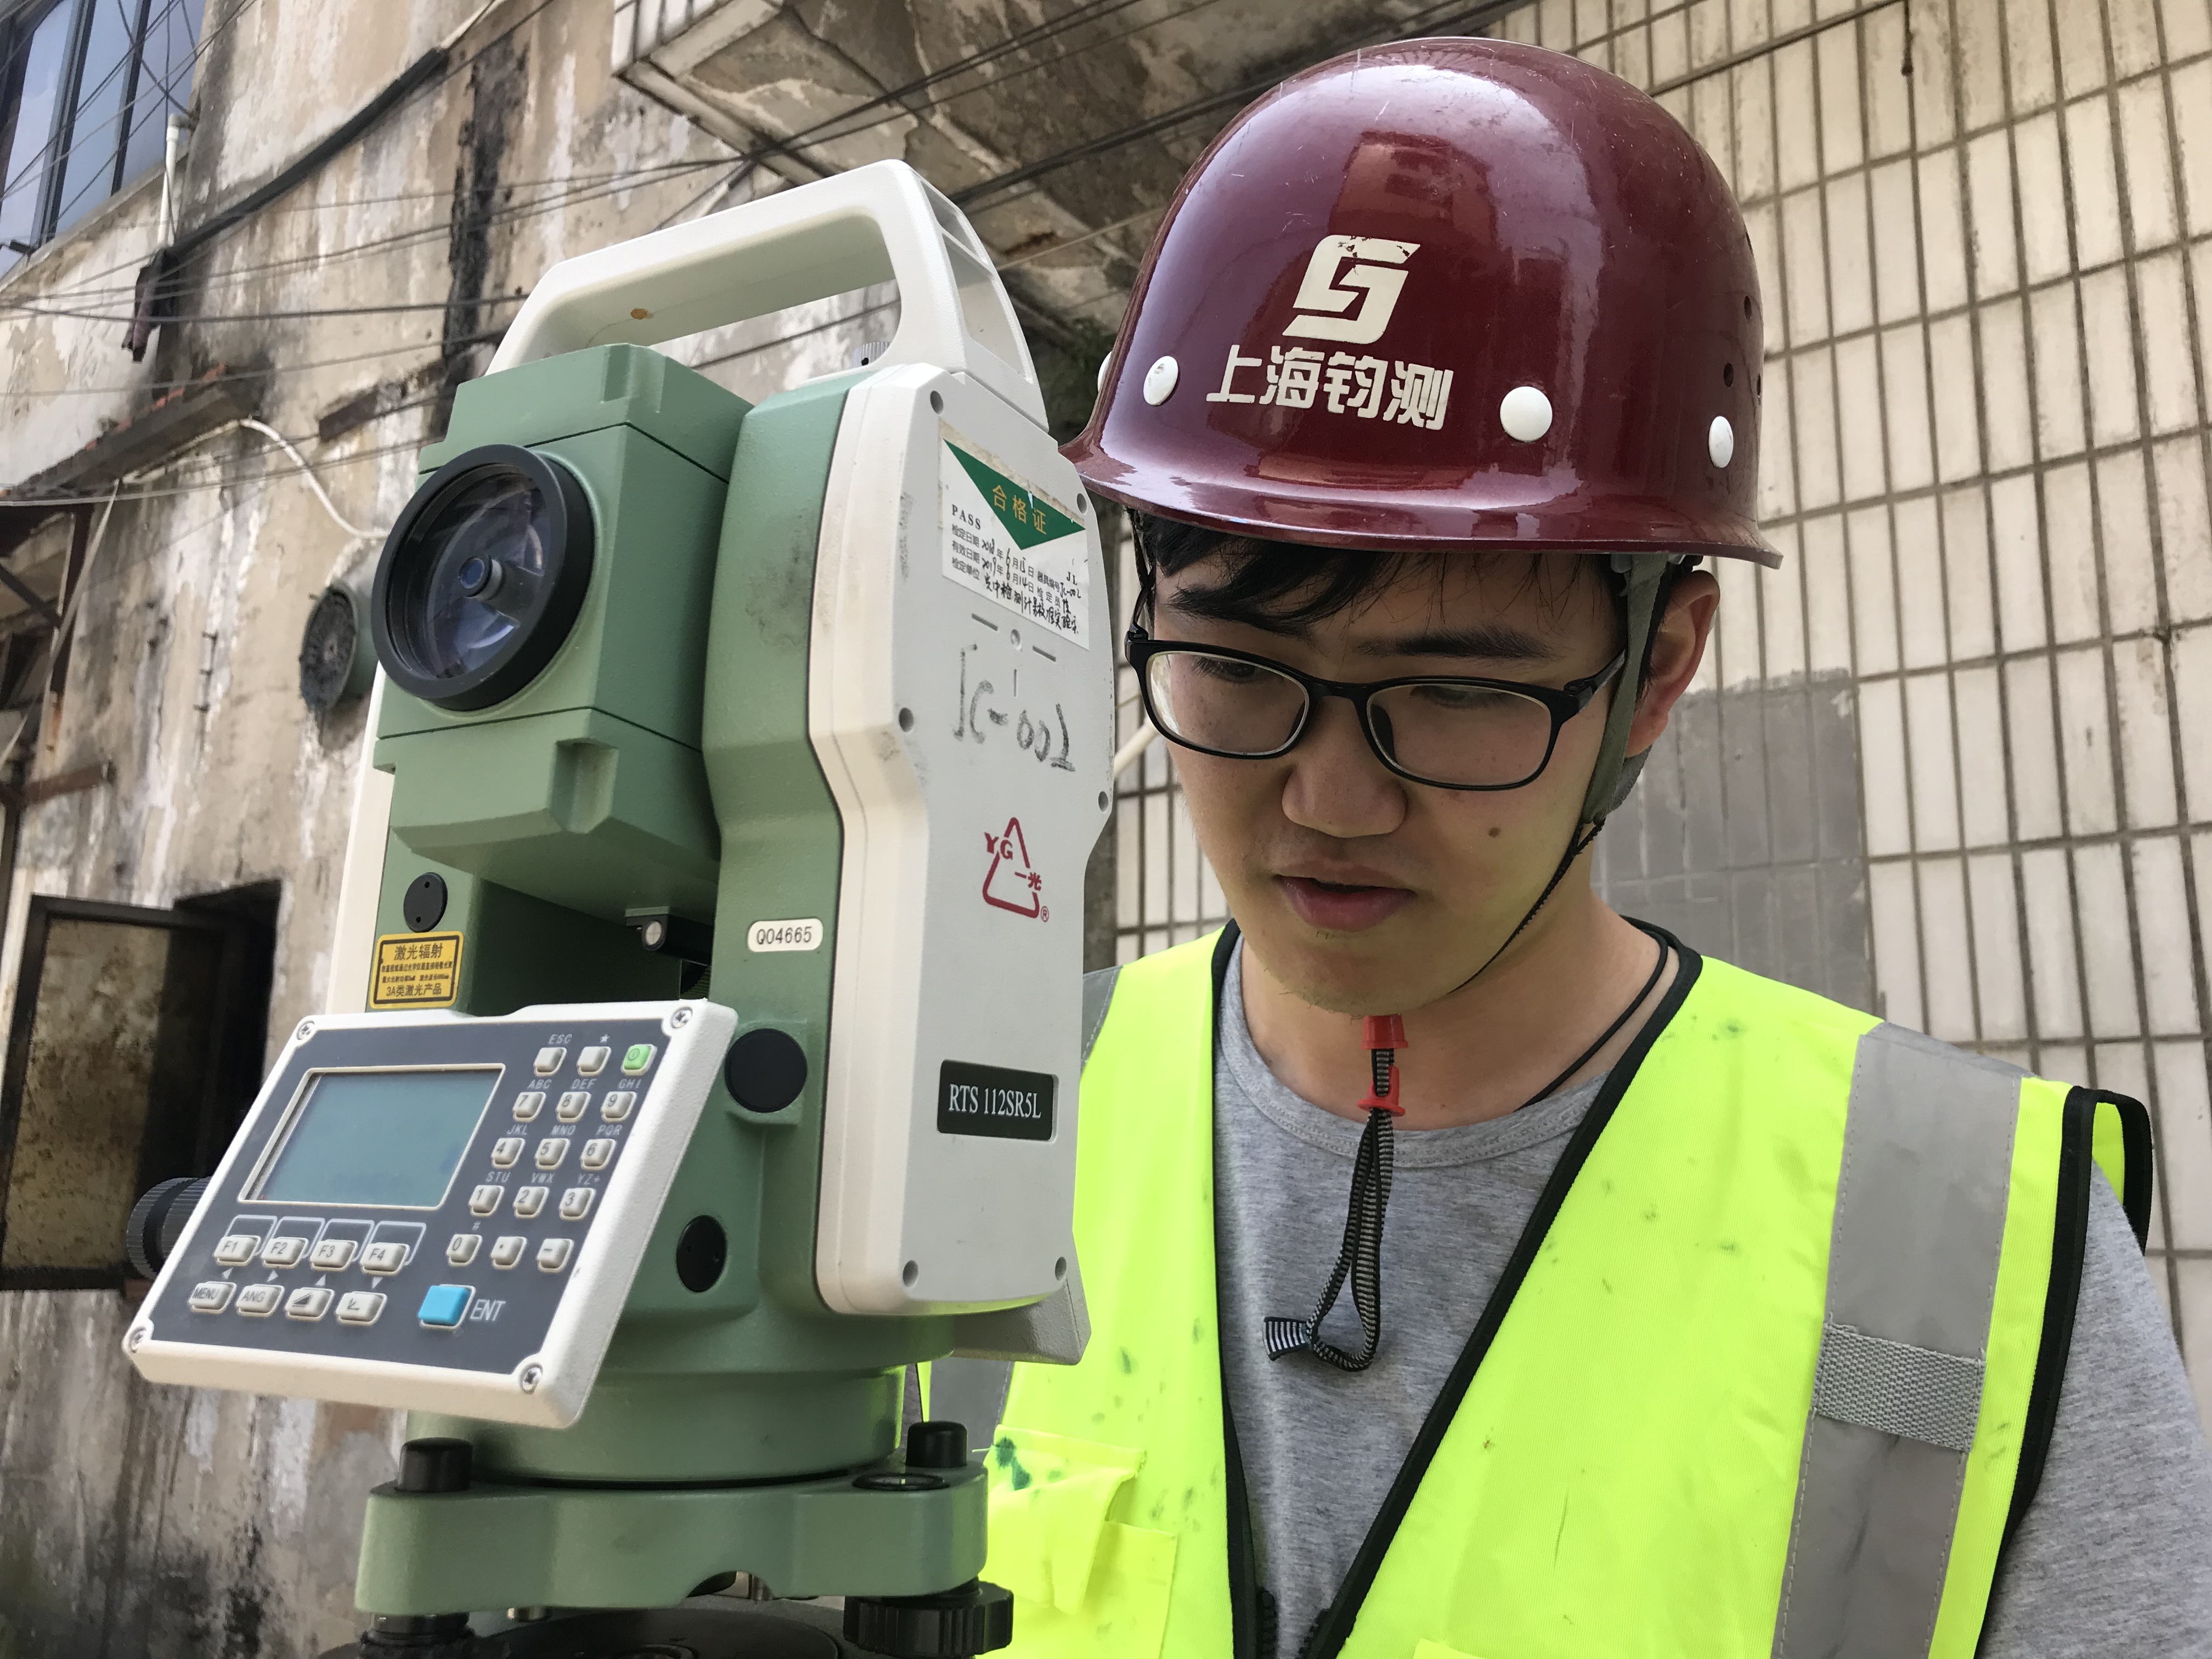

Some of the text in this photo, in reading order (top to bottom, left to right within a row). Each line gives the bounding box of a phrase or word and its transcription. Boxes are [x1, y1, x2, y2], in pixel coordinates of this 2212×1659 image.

[1206, 345, 1454, 431] 上海钧测
[951, 504, 981, 530] PASS
[992, 485, 1047, 535] 合格证
[984, 831, 1013, 860] YG
[393, 942, 444, 960] 激光辐射
[386, 983, 442, 997] 3A类激光产品
[549, 1034, 573, 1044] ESC
[527, 1079, 641, 1090] ABC DEF GHI
[518, 1094, 617, 1107] 7 8 9
[948, 1084, 1042, 1119] RTS 112SR5L
[507, 1125, 622, 1136] JKL MNO PQR
[496, 1142, 596, 1155] 4 5 6
[486, 1172, 511, 1183] STU
[532, 1172, 555, 1183] VWX
[477, 1189, 575, 1206] 1 2 3
[222, 1240, 387, 1261] F1 F2 F3 F4
[193, 1286, 266, 1304] MENU ANG
[470, 1298, 506, 1321] ENT
